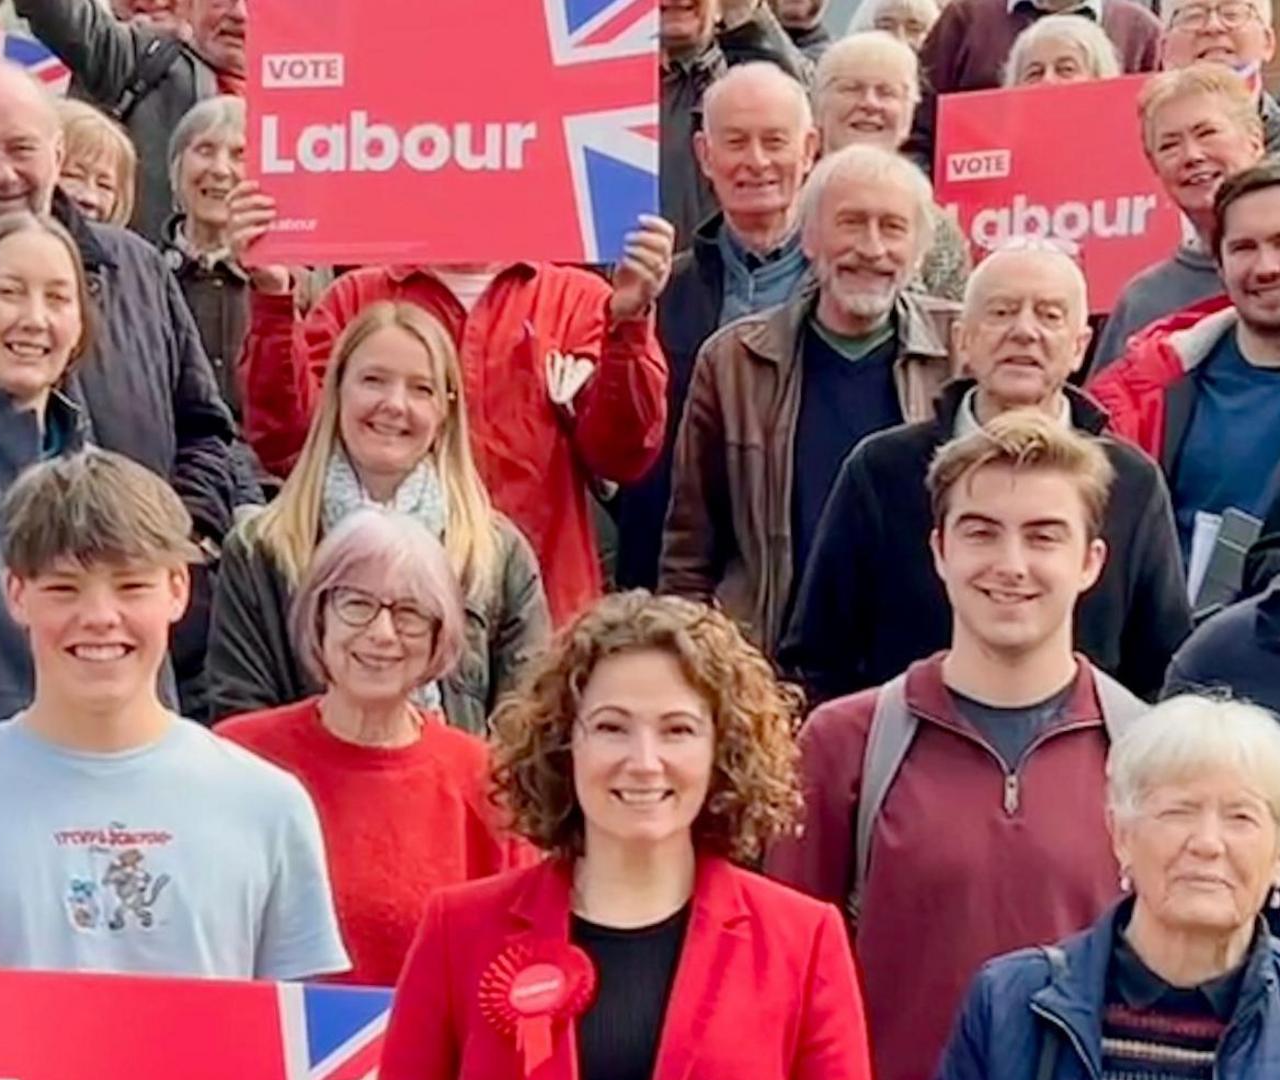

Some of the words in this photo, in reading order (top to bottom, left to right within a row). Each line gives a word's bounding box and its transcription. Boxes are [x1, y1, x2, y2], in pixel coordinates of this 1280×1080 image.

[268, 60, 340, 80] VOTE
[261, 111, 537, 172] Labour
[951, 155, 1006, 175] VOTE
[944, 194, 1157, 249] abour
